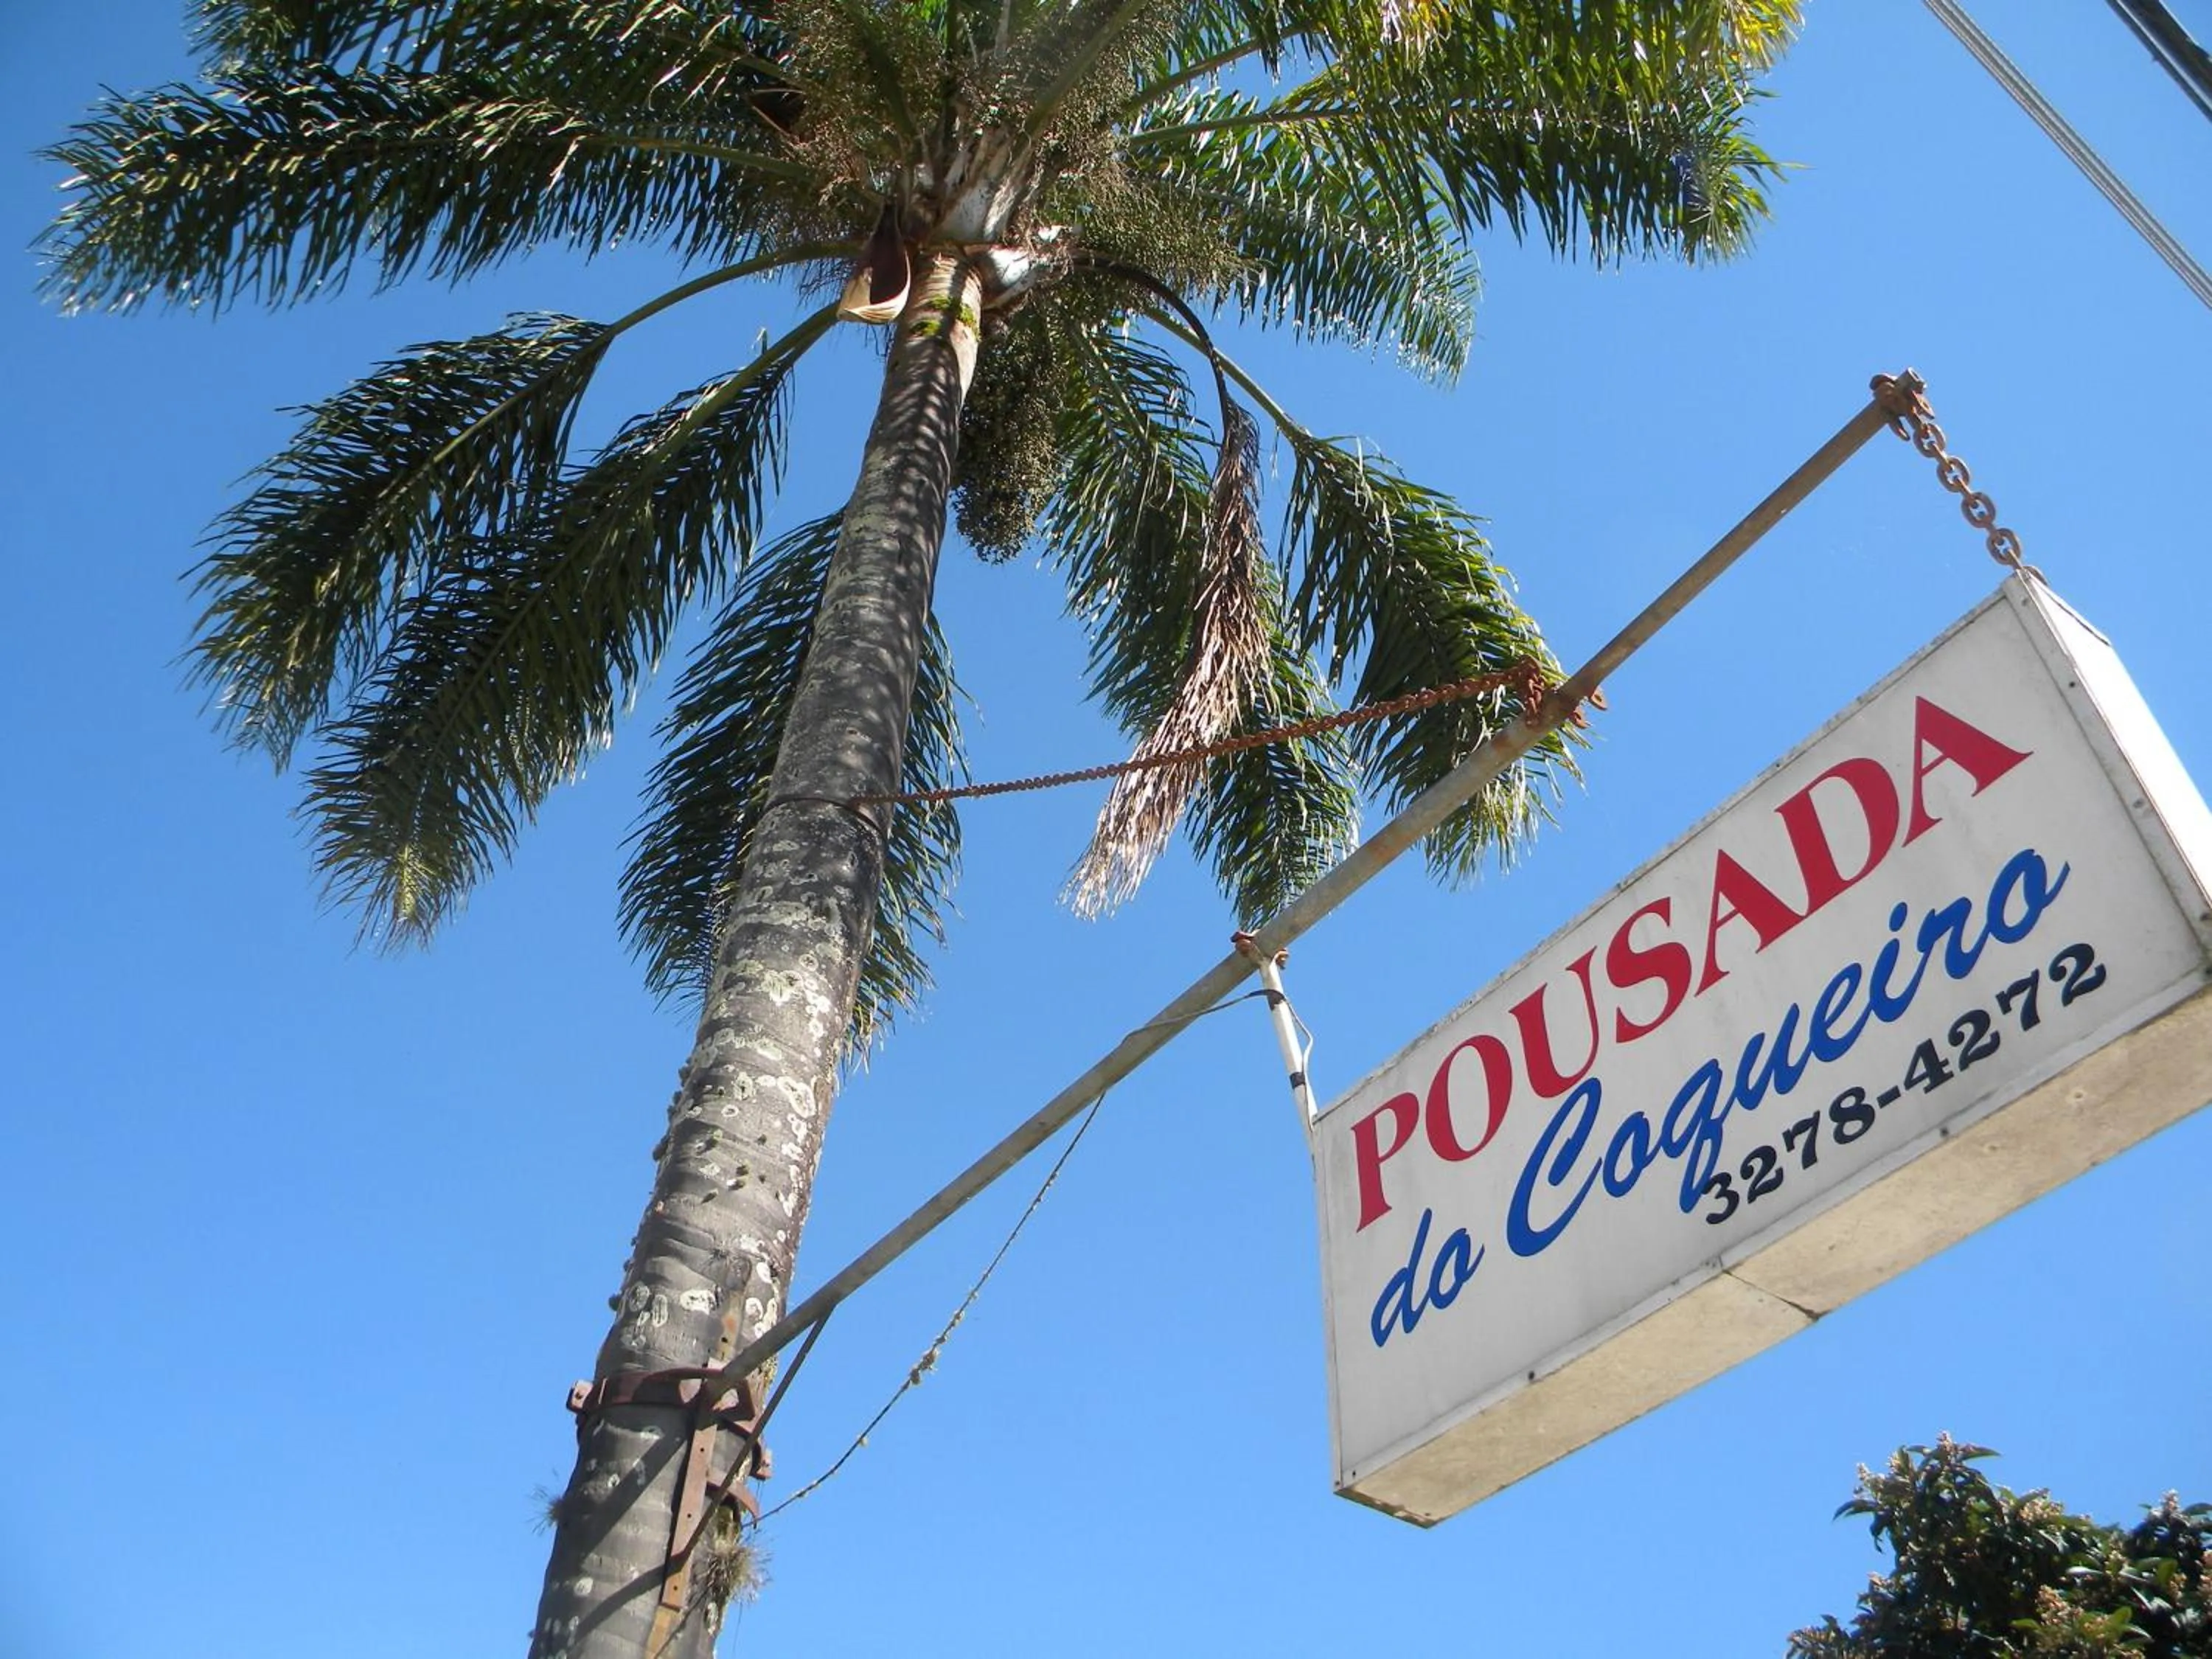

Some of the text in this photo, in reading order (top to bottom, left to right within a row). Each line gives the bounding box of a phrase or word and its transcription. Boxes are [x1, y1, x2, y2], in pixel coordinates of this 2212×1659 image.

[1351, 695, 2034, 1232] POUSADA
[1369, 848, 2070, 1348] do Coqueiro
[1703, 942, 2107, 1225] 3278-4272
